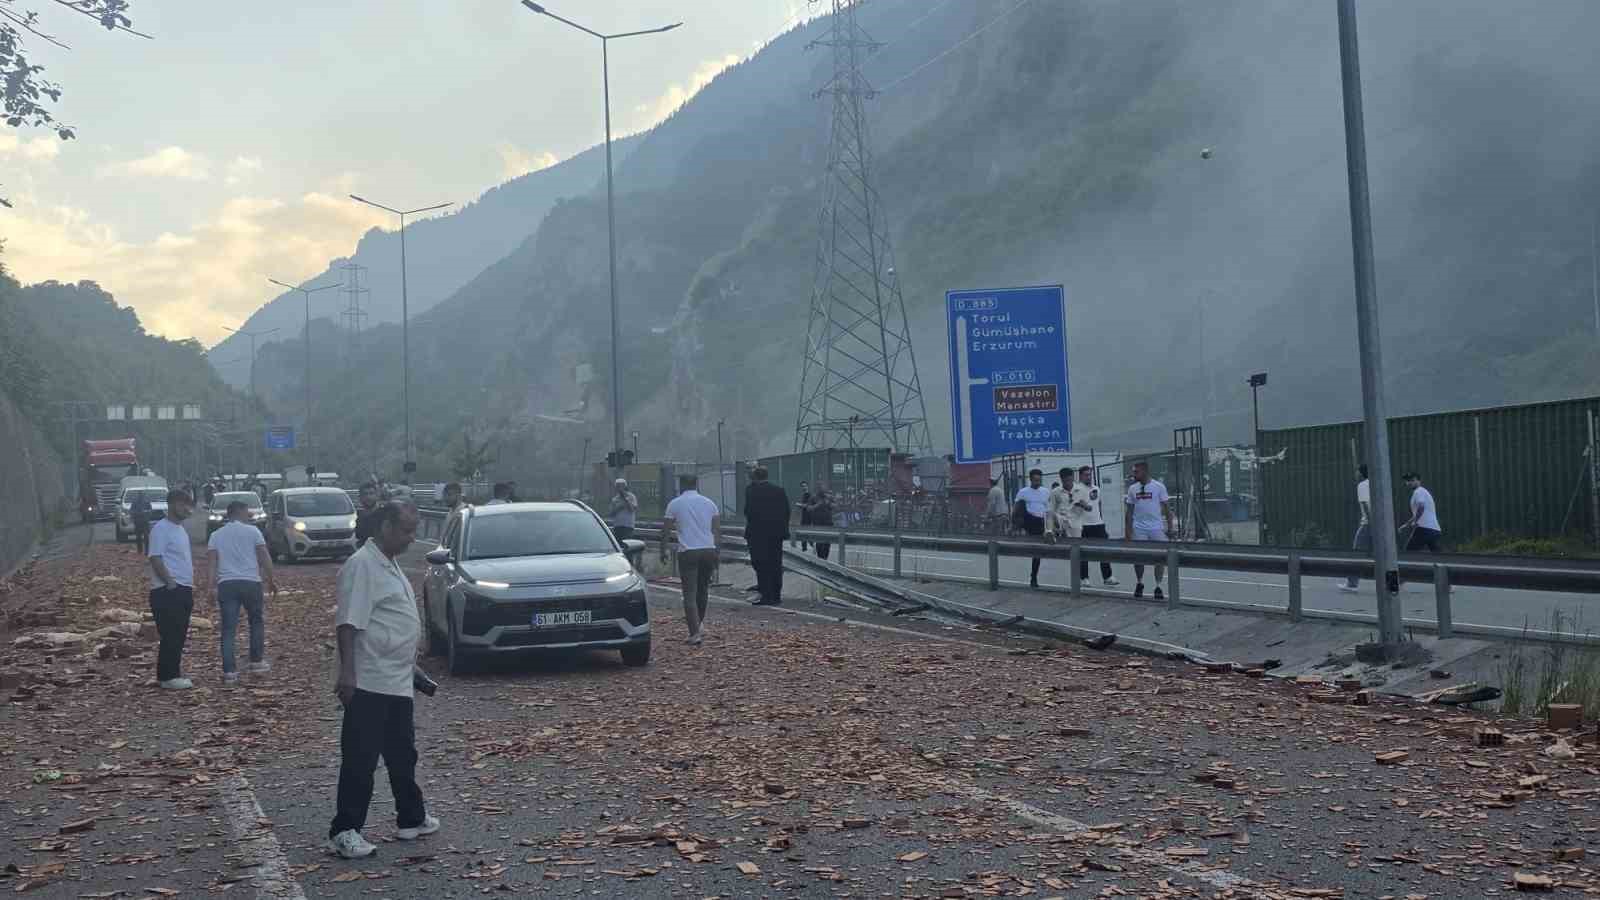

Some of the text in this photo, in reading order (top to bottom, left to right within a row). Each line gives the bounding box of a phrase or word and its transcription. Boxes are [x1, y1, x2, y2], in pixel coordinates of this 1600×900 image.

[972, 312, 1010, 323] Torul
[972, 325, 1055, 337] Gümüşhane
[972, 341, 1037, 352] Erzurum
[998, 415, 1045, 427] Maçka
[1000, 428, 1060, 440] Trabzon
[537, 614, 547, 625] 61
[553, 613, 570, 625] AKM
